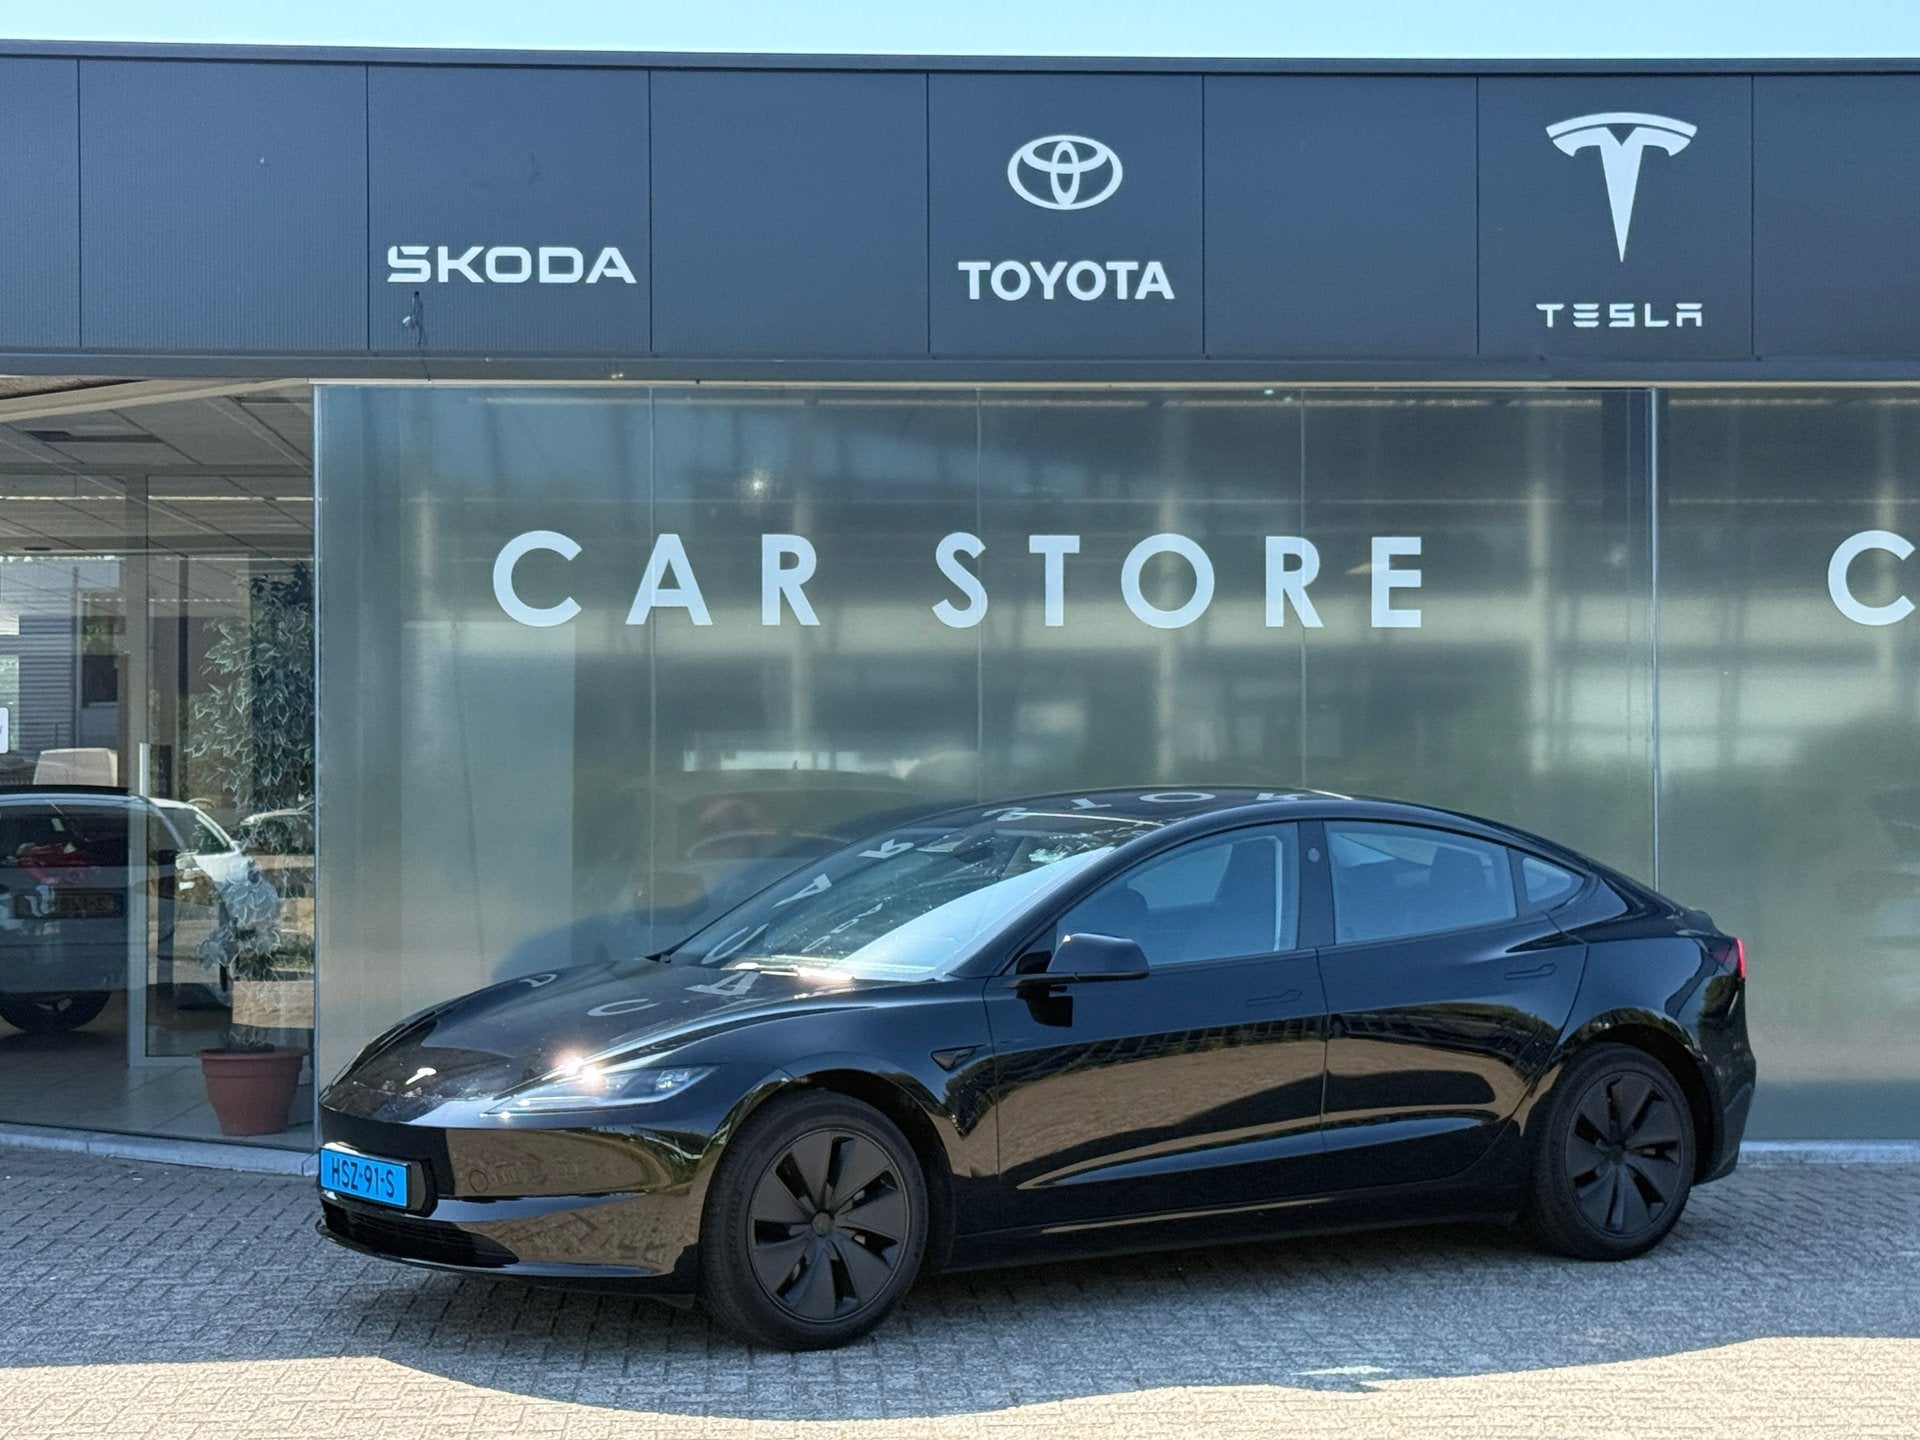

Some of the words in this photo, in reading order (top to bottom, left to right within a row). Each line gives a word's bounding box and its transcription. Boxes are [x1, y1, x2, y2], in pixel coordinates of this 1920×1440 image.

[387, 246, 637, 284] SKODA
[958, 260, 1175, 301] TOYOTA
[1536, 303, 1703, 328] TESLA
[492, 530, 821, 627] CAR
[932, 532, 1423, 629] STORE
[1827, 530, 1916, 627] C
[331, 1157, 395, 1198] HSZ-91-S
